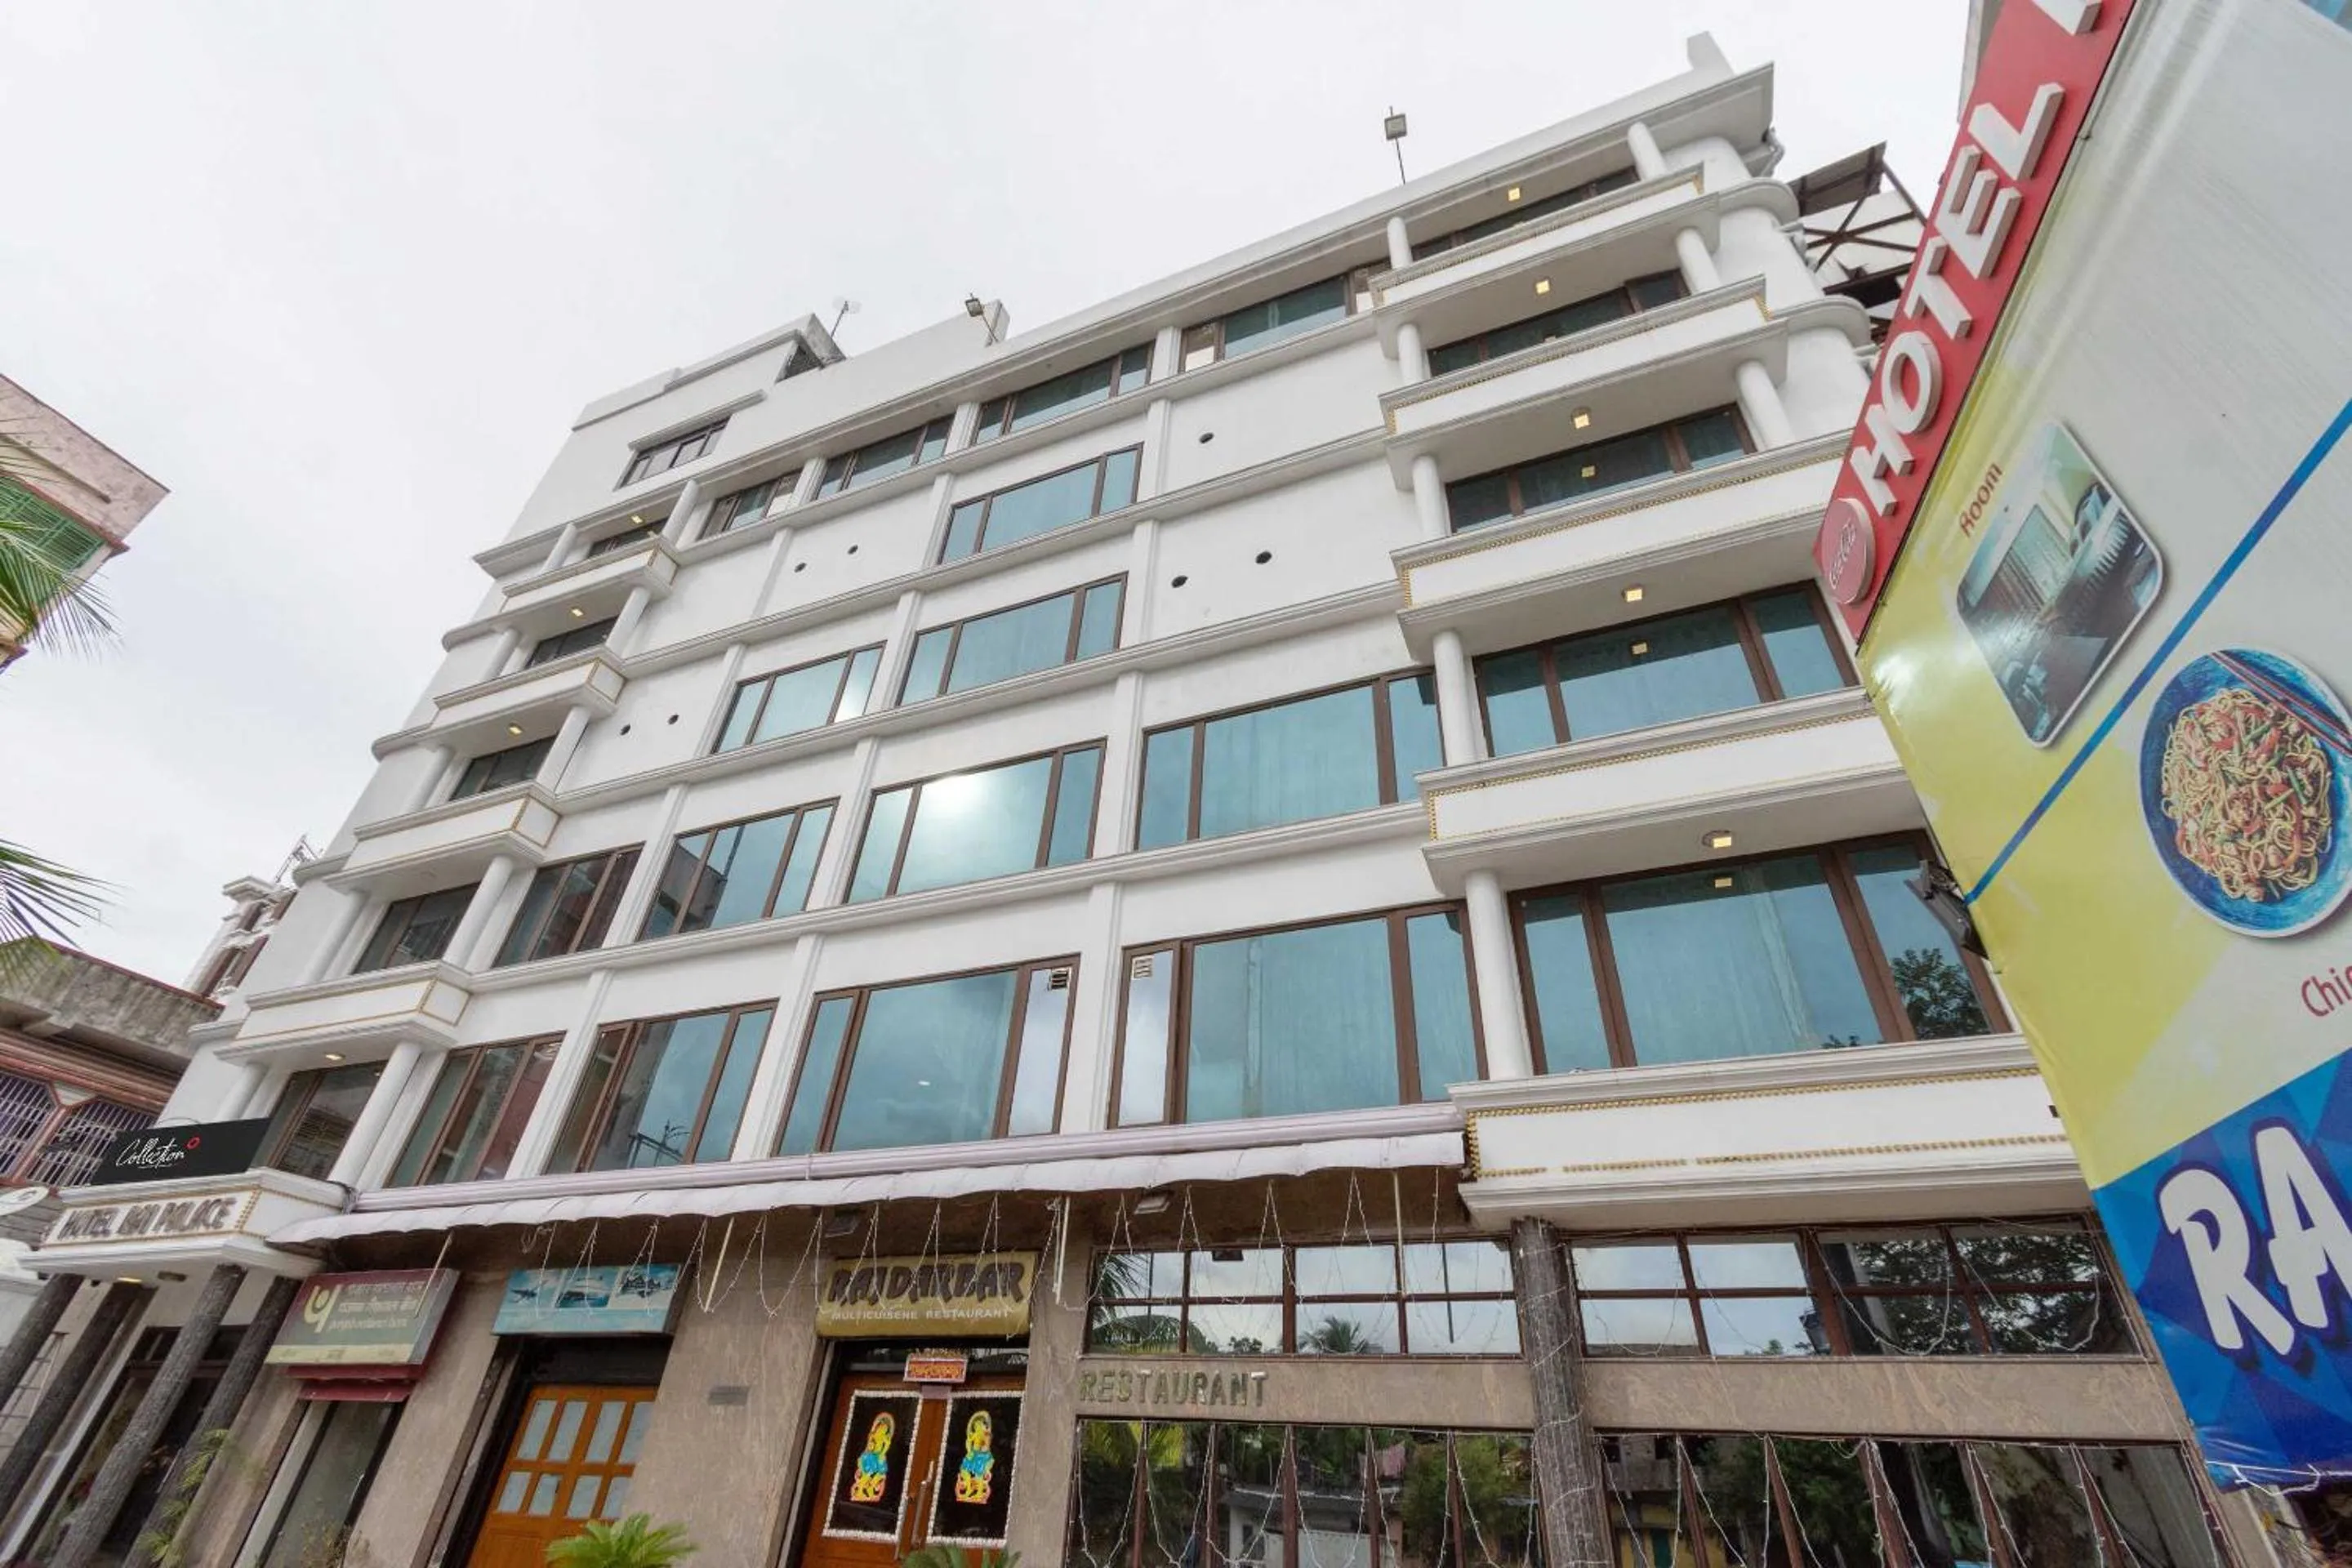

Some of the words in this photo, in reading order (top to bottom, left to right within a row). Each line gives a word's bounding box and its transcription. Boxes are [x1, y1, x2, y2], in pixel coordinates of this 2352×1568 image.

[1850, 82, 2065, 518] HOTEL
[1958, 463, 2003, 539] Room
[114, 1137, 185, 1169] Collection
[925, 1308, 1010, 1320] RESTAURANT
[1078, 1369, 1269, 1407] RESTAURANT
